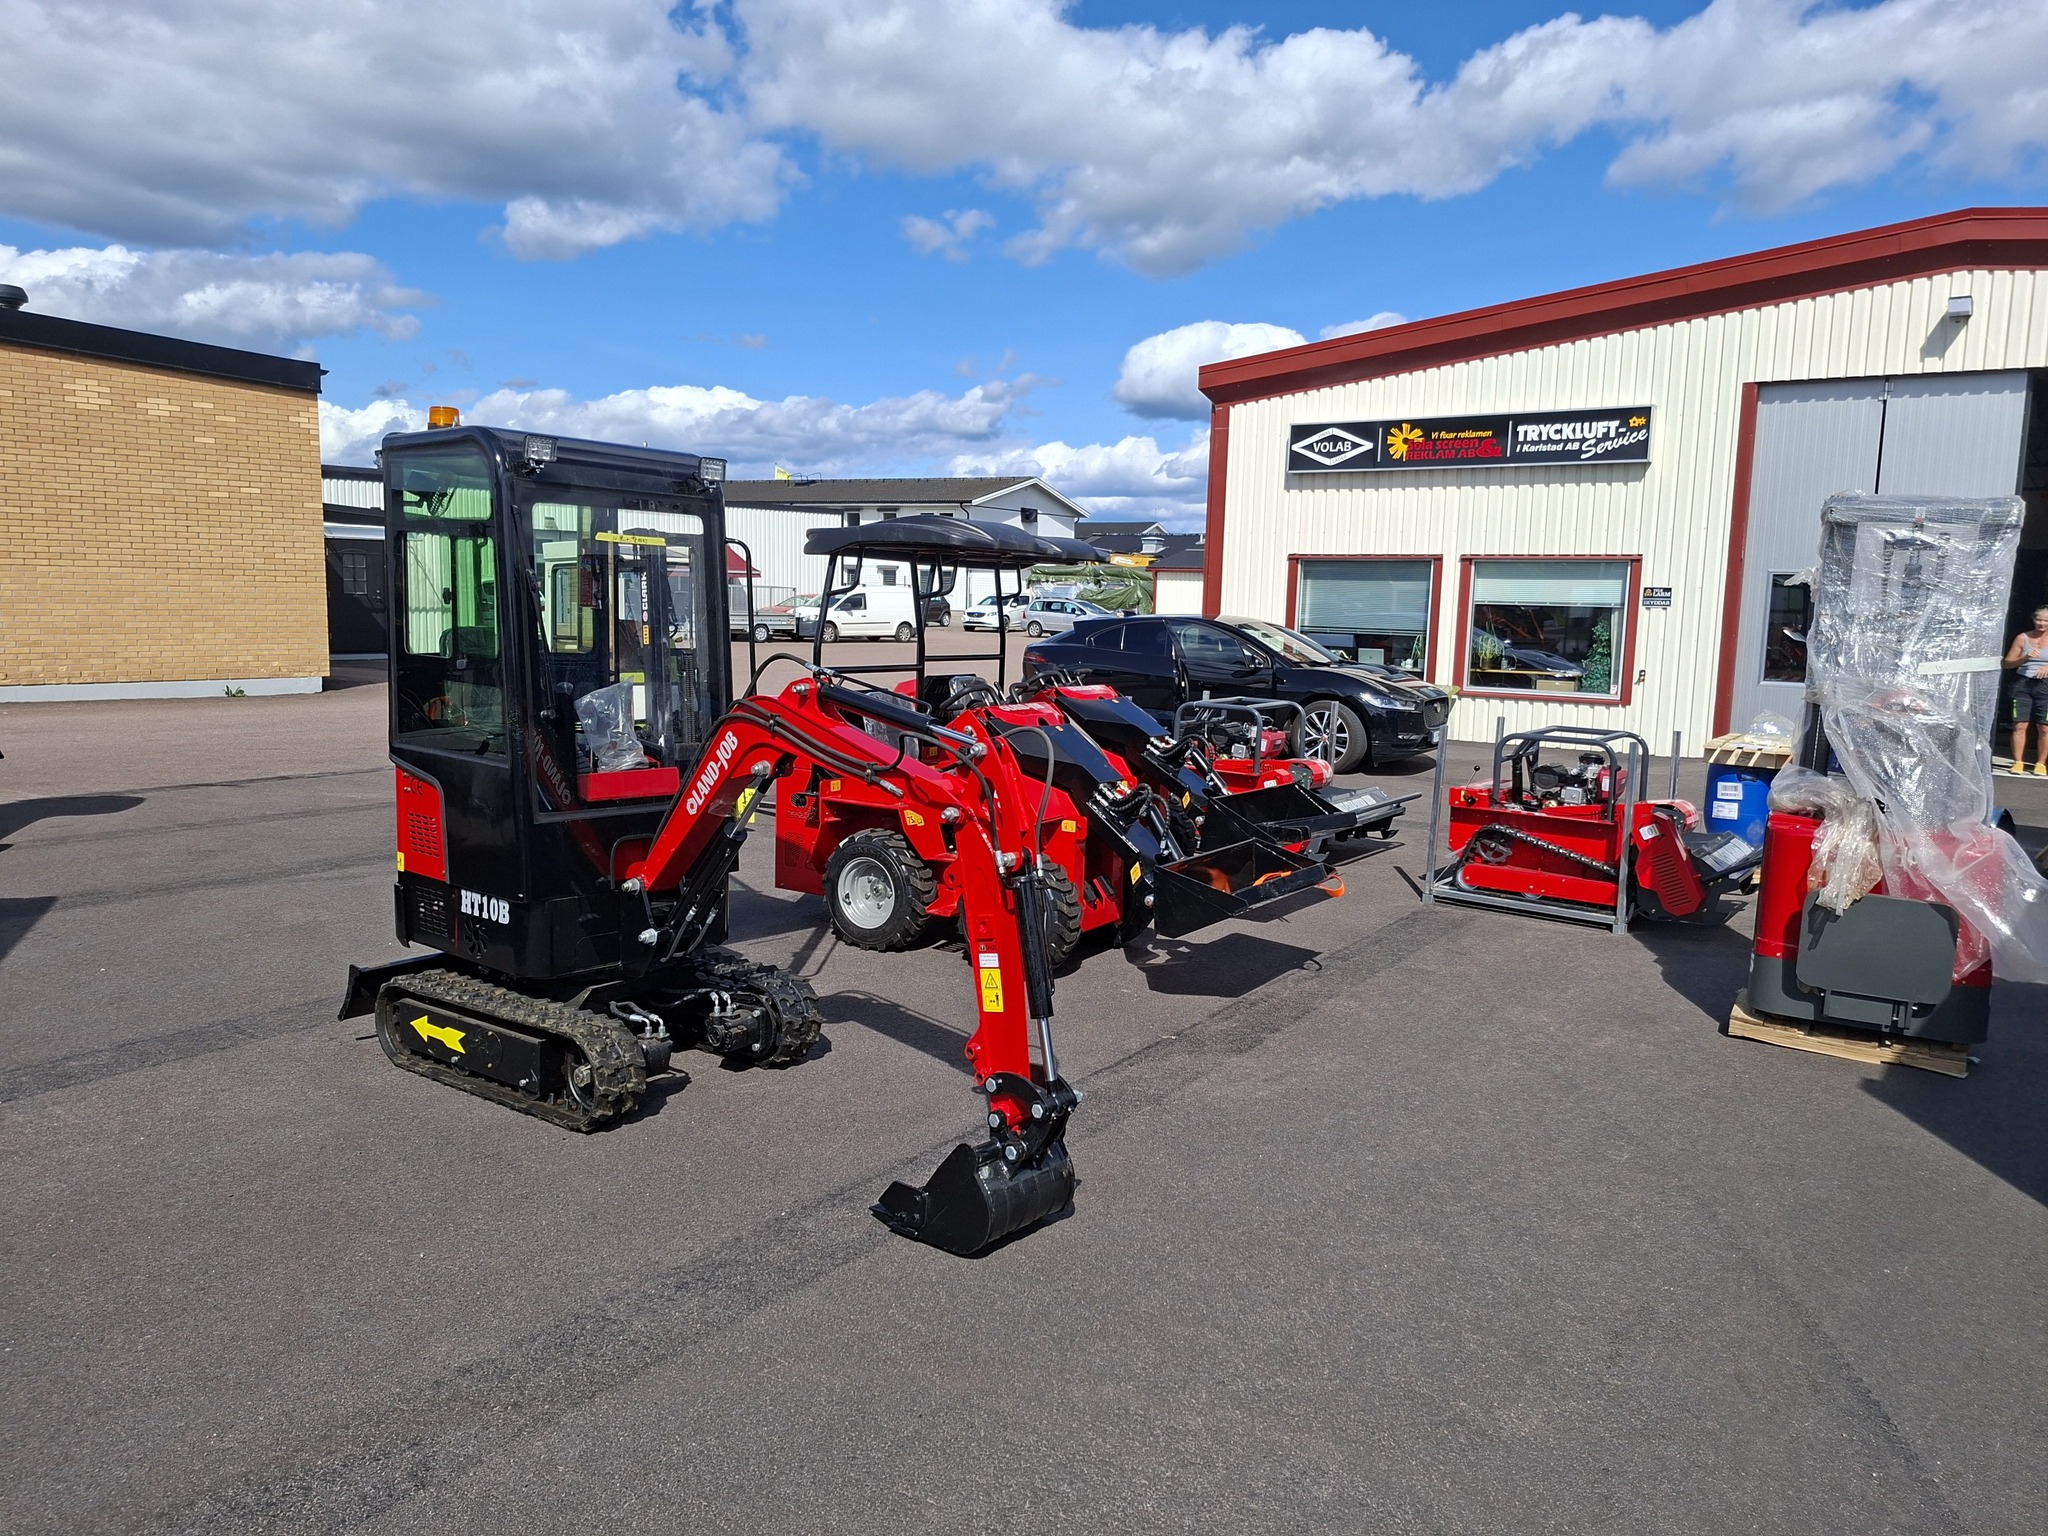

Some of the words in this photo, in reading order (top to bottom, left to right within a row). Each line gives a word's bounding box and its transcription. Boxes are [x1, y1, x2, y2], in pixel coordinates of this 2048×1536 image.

[1431, 432, 1439, 440] Vi
[1439, 431, 1457, 440] fixar
[1457, 429, 1493, 439] reklamen
[1516, 420, 1627, 442] TRYCKLUFT-
[1313, 441, 1352, 453] VOLAB
[1407, 440, 1432, 451] Sola
[1436, 438, 1479, 450] screen
[1522, 442, 1564, 452] Karlstad
[1565, 441, 1580, 451] AB
[1580, 428, 1649, 460] Service
[1406, 448, 1455, 461] REKLAM
[1457, 448, 1476, 459] AB
[461, 889, 510, 925] HT10B
